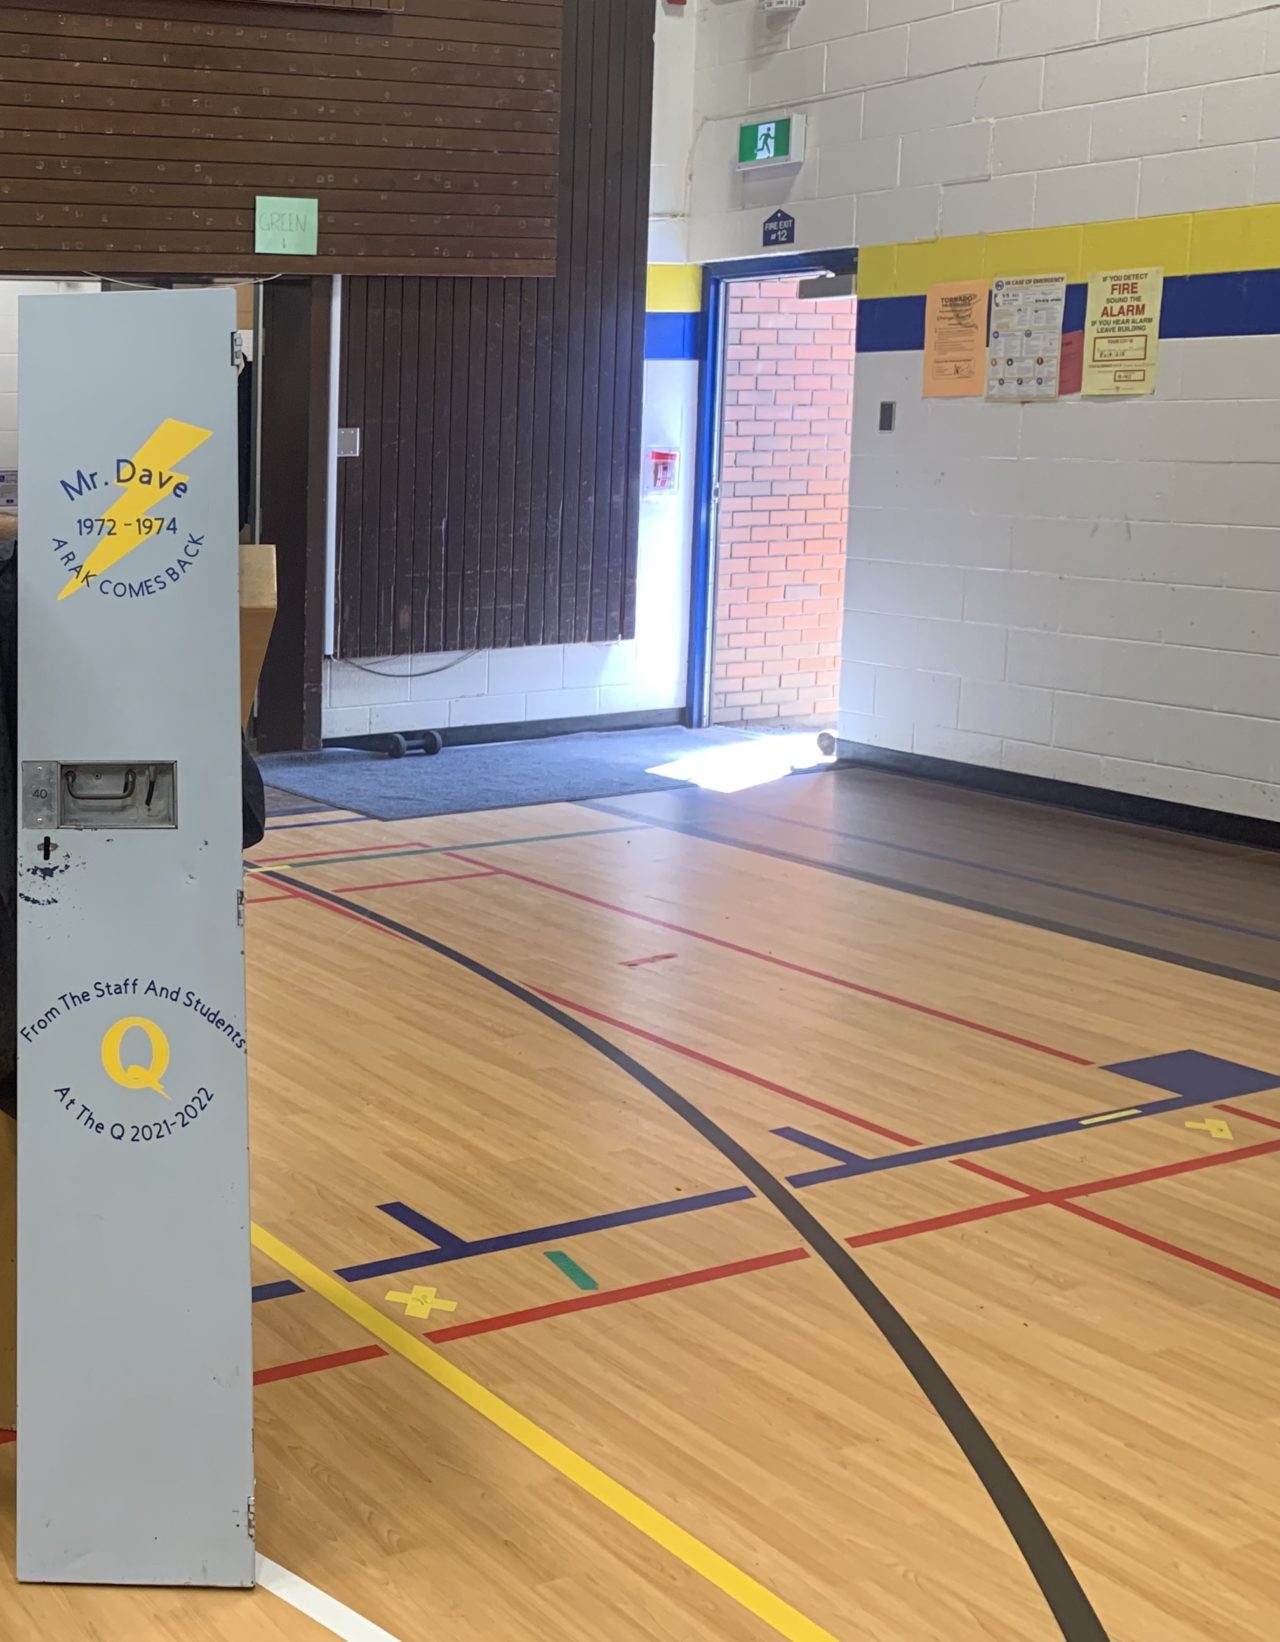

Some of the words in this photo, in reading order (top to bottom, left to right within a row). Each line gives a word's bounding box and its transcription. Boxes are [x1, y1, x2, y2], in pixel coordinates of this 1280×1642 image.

[259, 211, 308, 232] GREEN
[765, 221, 778, 231] FIRE
[779, 219, 793, 229] EXIT
[770, 230, 788, 241] #12
[1111, 282, 1139, 295] FIRE
[1101, 304, 1146, 318] ALARM
[59, 469, 109, 501] Mr.
[116, 459, 188, 499] Dave
[77, 518, 117, 536] 1972
[136, 517, 178, 535] 1974
[99, 574, 167, 599] COMES
[165, 533, 205, 582] BACK
[32, 789, 48, 799] 40
[19, 1006, 61, 1043] From
[58, 990, 91, 1011] The
[93, 978, 139, 999] Staff
[144, 979, 181, 1002] And
[182, 991, 247, 1050] Students
[101, 1016, 172, 1101] Q
[53, 1087, 76, 1110] At
[75, 1104, 105, 1134] The
[110, 1122, 125, 1141] Q
[130, 1087, 215, 1142] 2021-2022
